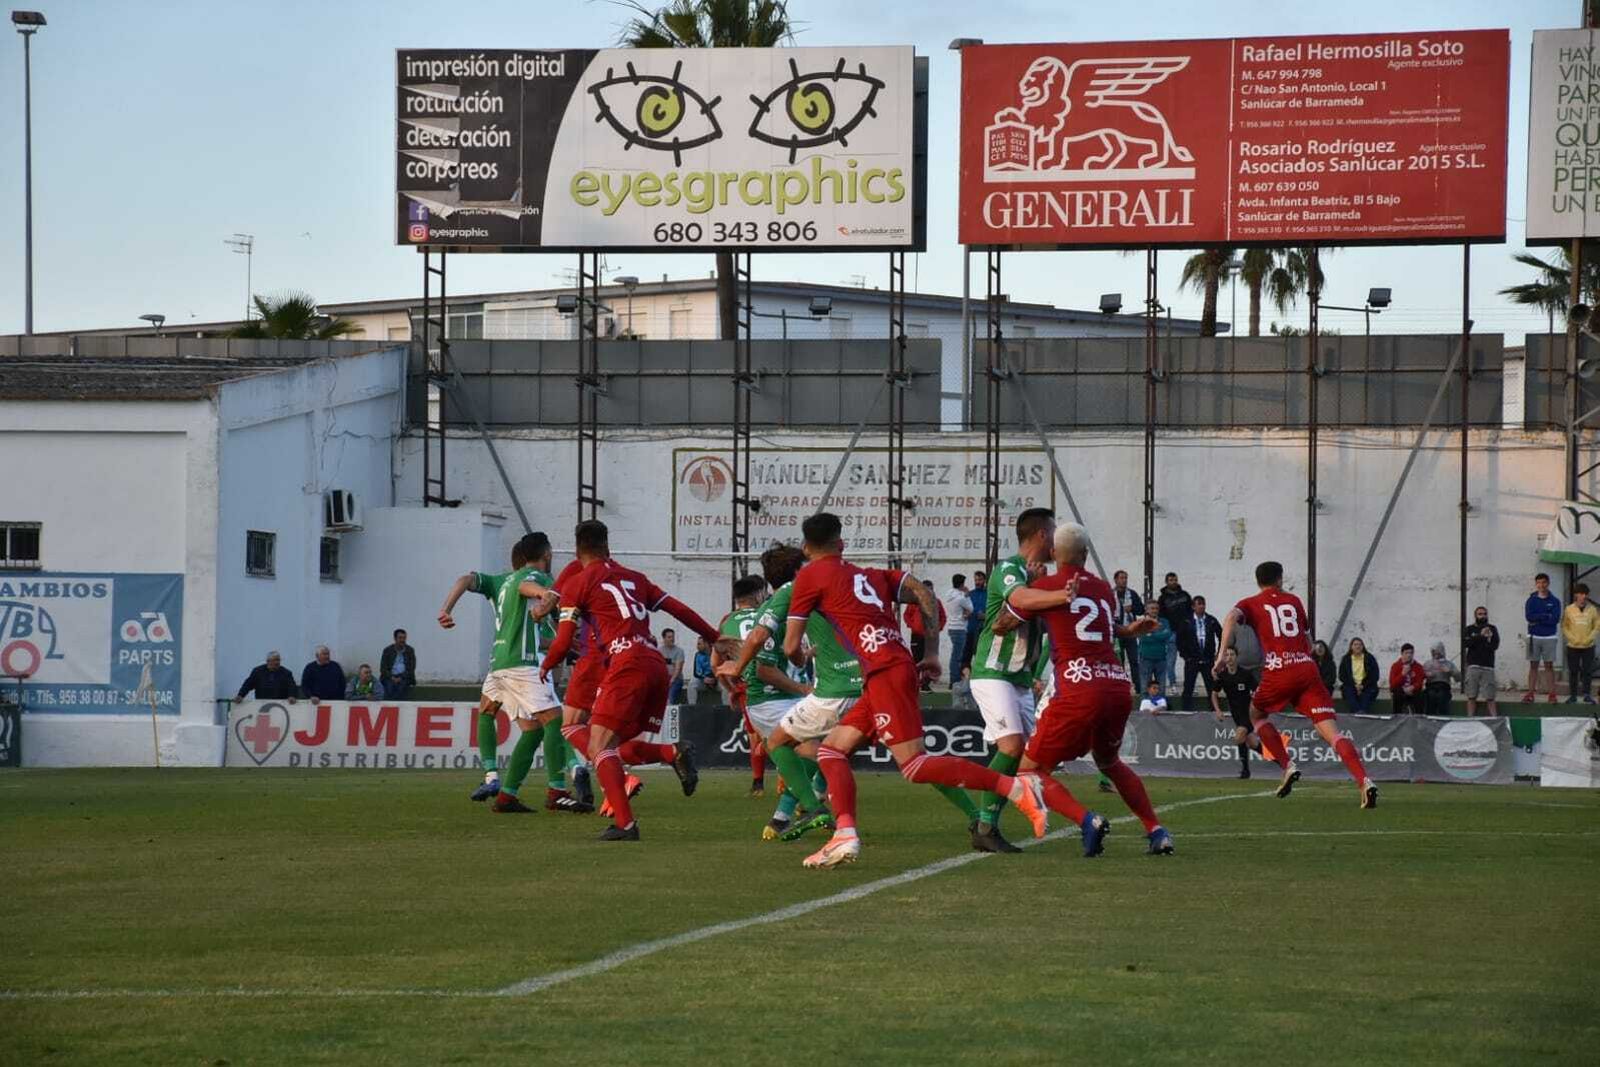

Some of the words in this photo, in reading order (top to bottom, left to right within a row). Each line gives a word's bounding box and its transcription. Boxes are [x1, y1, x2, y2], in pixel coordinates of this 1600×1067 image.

[1242, 43, 1301, 62] Rafael
[1308, 41, 1413, 60] Hermosilla
[1418, 40, 1464, 56] Soto
[1559, 47, 1596, 62] HAY
[406, 54, 499, 81] impresión
[505, 53, 565, 80] digital
[1387, 59, 1420, 70] Agente
[1421, 57, 1464, 67] exclusivo
[1242, 71, 1255, 80] M.
[1257, 70, 1277, 80] 647
[1280, 70, 1300, 80] 994
[1301, 69, 1322, 79] 798
[1241, 84, 1253, 95] C/
[1255, 84, 1276, 94] Nao
[1278, 84, 1298, 94] San
[1349, 82, 1378, 92] Local
[1381, 81, 1386, 91] 1
[1241, 98, 1286, 110] Sanlúcar
[1289, 97, 1302, 108] de
[1305, 96, 1364, 107] Barrameda
[1557, 107, 1583, 121] UN
[1239, 142, 1302, 156] Rosario
[1308, 139, 1396, 156] Rodríguez
[1419, 143, 1447, 152] Agente
[1448, 142, 1486, 152] exclusivo
[406, 161, 498, 183] corporeos
[1239, 158, 1324, 174] Asociados
[1329, 155, 1404, 172] Sanlúcar
[1408, 155, 1451, 169] 2015
[1455, 154, 1486, 168] S.L.
[569, 156, 906, 216] eyesgraphics
[1239, 182, 1252, 192] M.
[1254, 182, 1274, 192] 607
[1276, 182, 1296, 192] 639
[1299, 181, 1319, 191] 050
[983, 189, 1195, 228] GENERALI
[1238, 196, 1268, 208] Avda.
[1270, 195, 1309, 207] Infanta
[1376, 194, 1401, 207] Bajo
[1552, 194, 1586, 214] UN
[1237, 210, 1283, 222] Sanlúcar
[1285, 210, 1299, 221] de
[1302, 209, 1361, 221] Barrameda
[429, 227, 489, 240] eyesgraphics
[654, 222, 702, 243] 680
[713, 221, 758, 242] 343
[766, 220, 817, 242] 806
[917, 516, 1019, 527] INDUSTRIALE
[601, 580, 648, 621] 15
[1070, 597, 1115, 642] 21
[1264, 604, 1299, 638] 18
[119, 649, 174, 666] PARTS
[60, 689, 77, 704] 956
[79, 689, 91, 704] 38
[1287, 746, 1309, 761] DE
[1314, 743, 1416, 763] SAÚCAR
